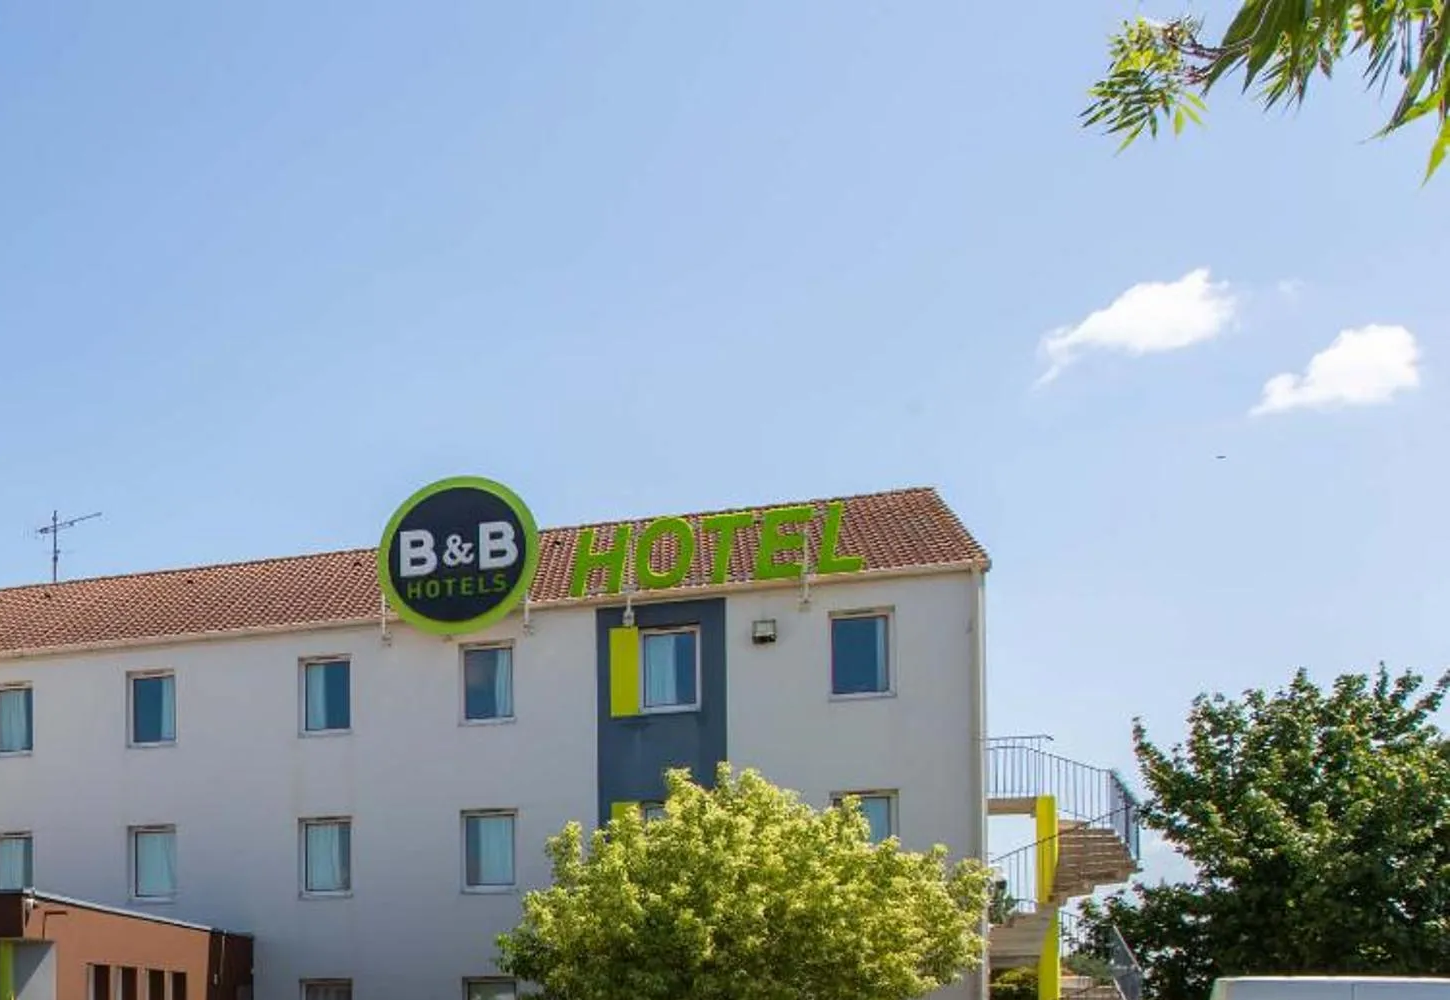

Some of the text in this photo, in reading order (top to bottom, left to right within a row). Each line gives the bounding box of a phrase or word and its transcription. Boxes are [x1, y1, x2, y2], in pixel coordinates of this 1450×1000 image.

[400, 521, 518, 577] B&B
[568, 501, 865, 597] HOTEL
[407, 574, 507, 599] HOTELS
